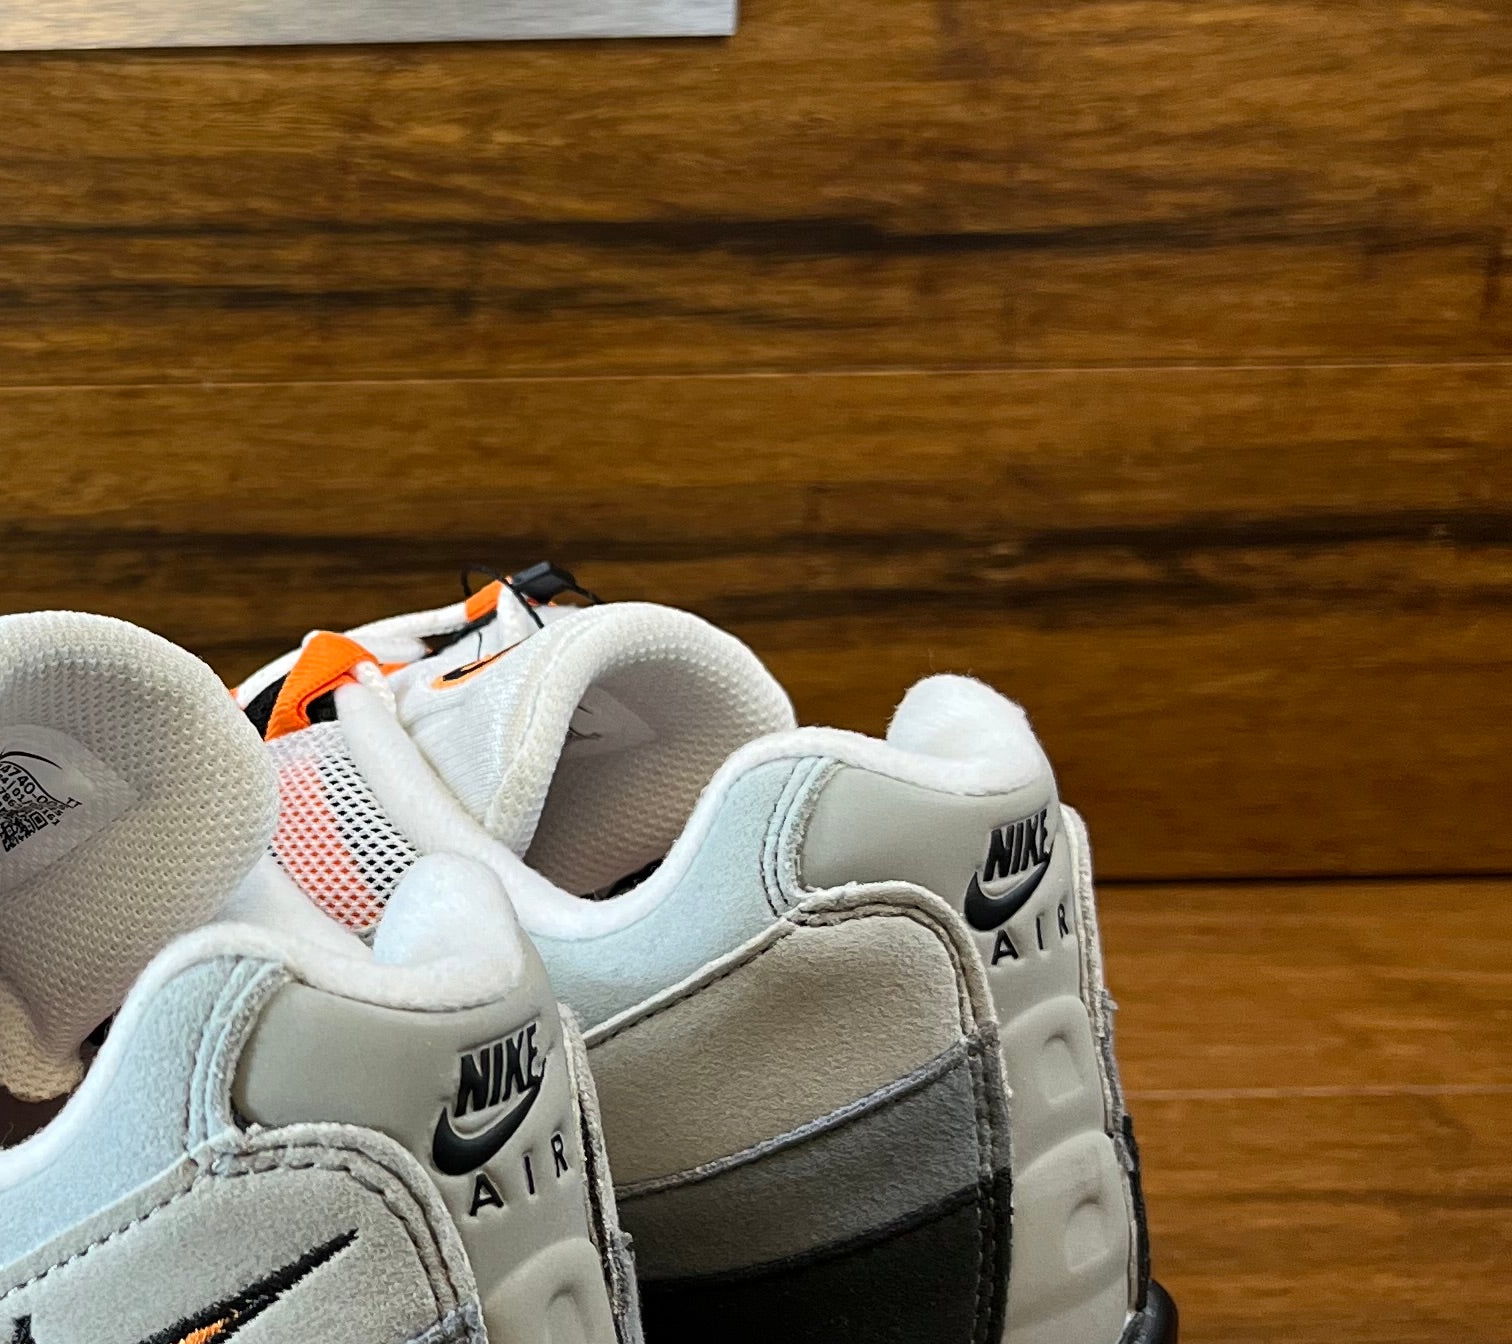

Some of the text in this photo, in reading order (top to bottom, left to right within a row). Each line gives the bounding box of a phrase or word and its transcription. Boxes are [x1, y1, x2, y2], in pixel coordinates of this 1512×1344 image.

[982, 807, 1051, 882] NIKE
[991, 903, 1069, 966] AIR
[453, 1022, 543, 1118] NIKE
[468, 1132, 569, 1217] AIR
